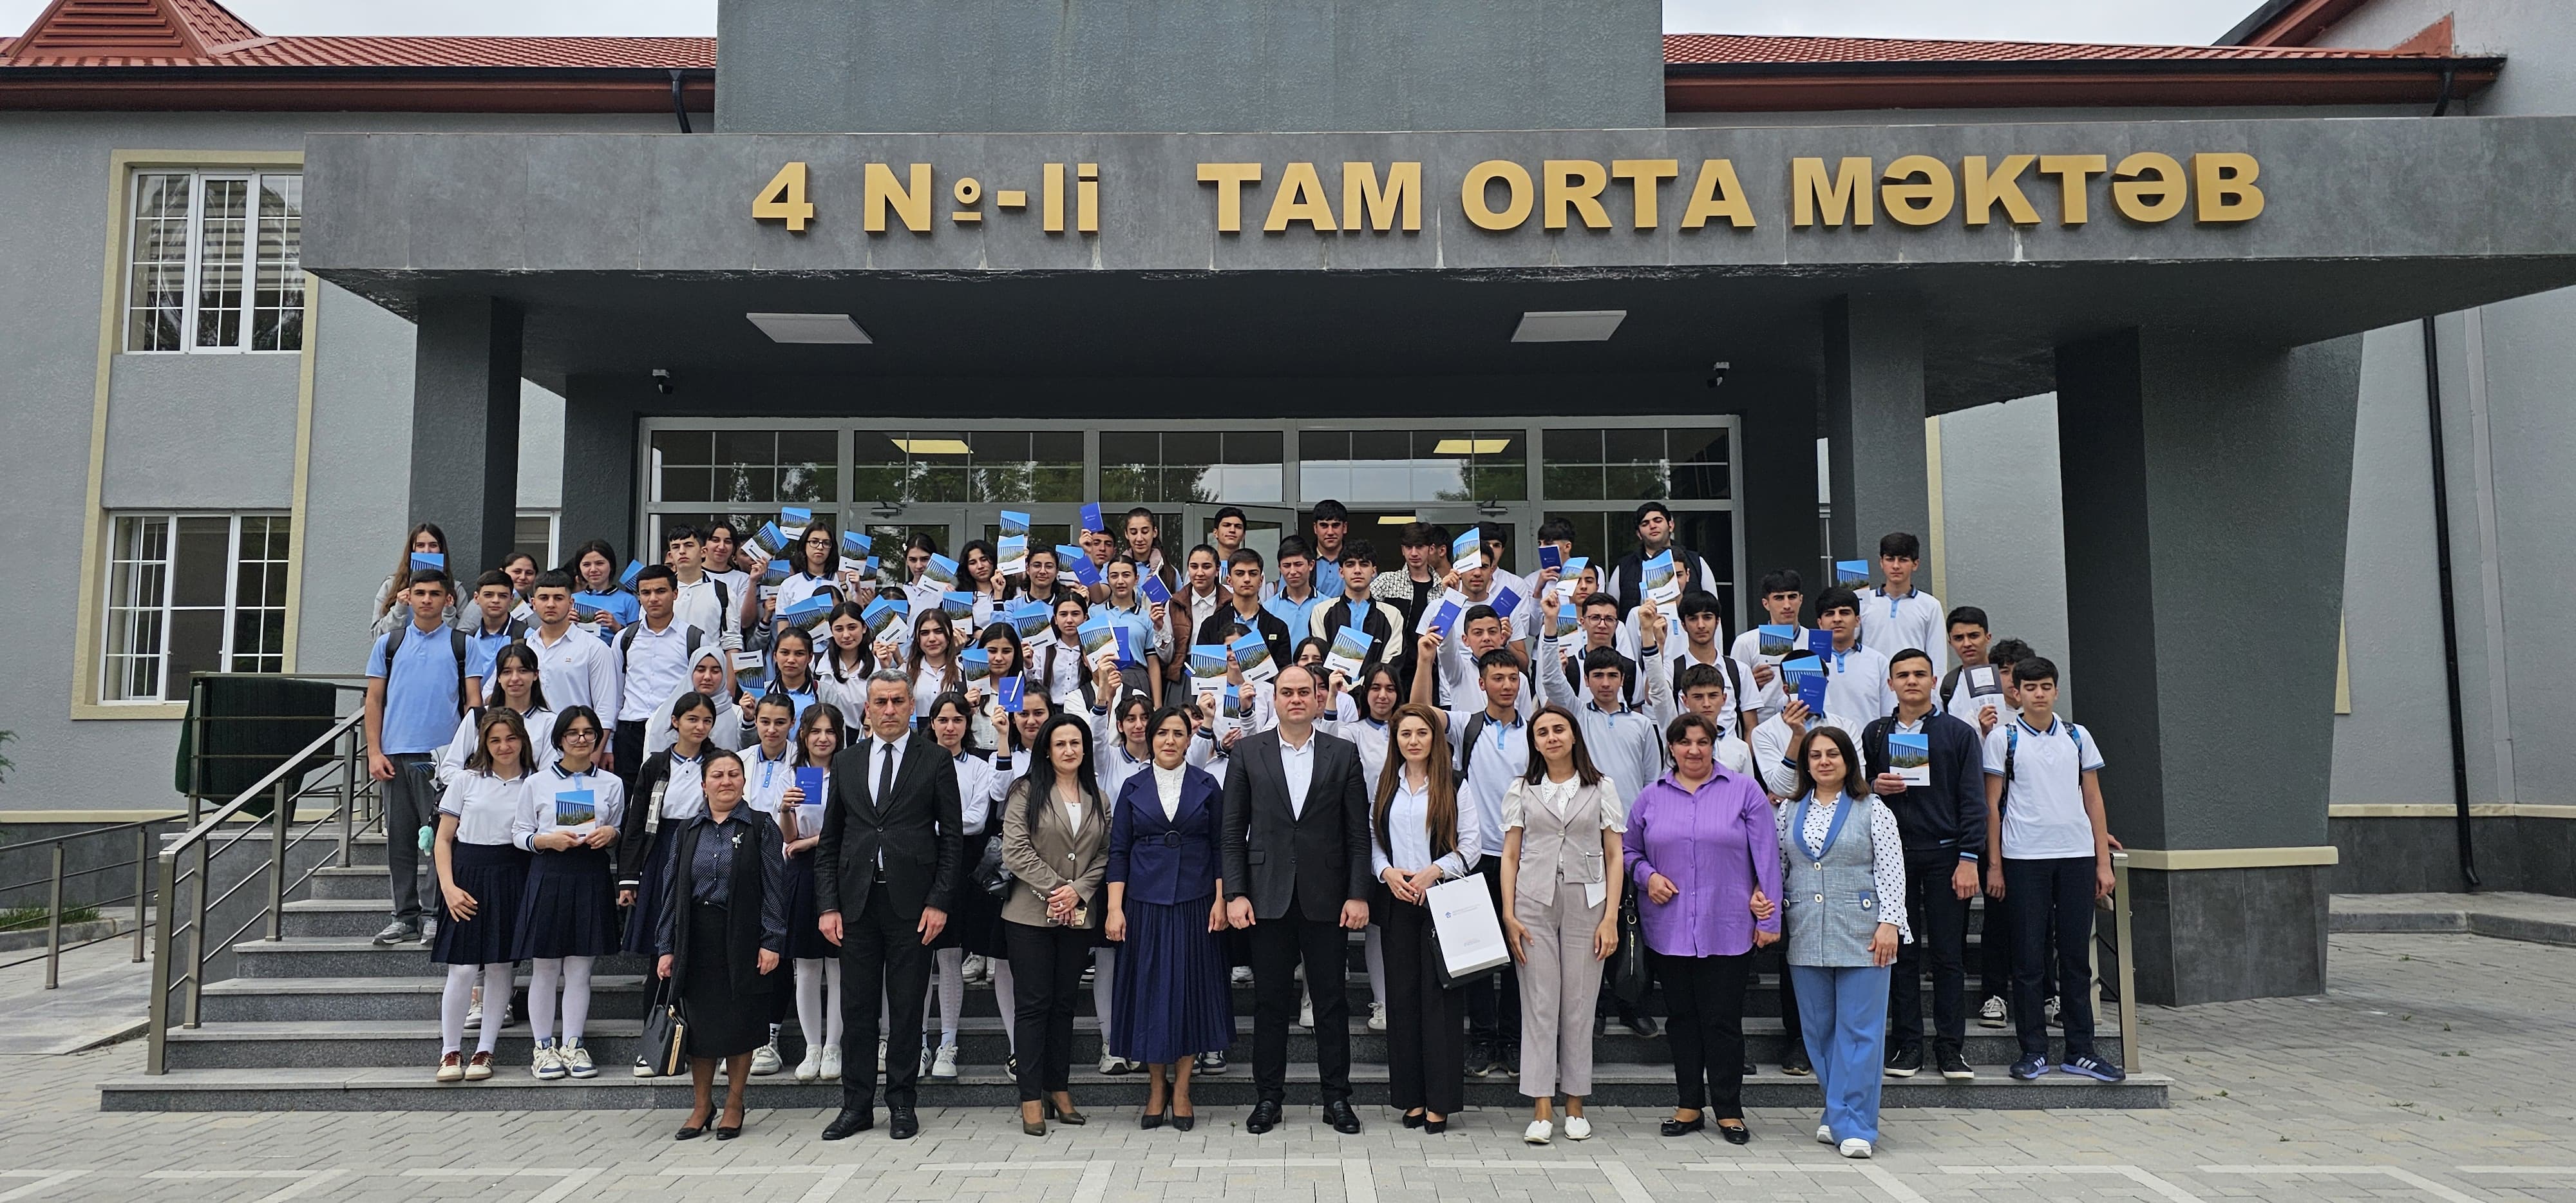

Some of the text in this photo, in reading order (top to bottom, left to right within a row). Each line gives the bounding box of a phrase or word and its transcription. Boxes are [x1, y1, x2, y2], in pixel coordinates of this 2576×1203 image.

[753, 162, 813, 231] 4
[1197, 162, 1421, 231] TAM
[1461, 158, 1756, 231] ORTA
[1792, 151, 2265, 227] MƏKTƏB
